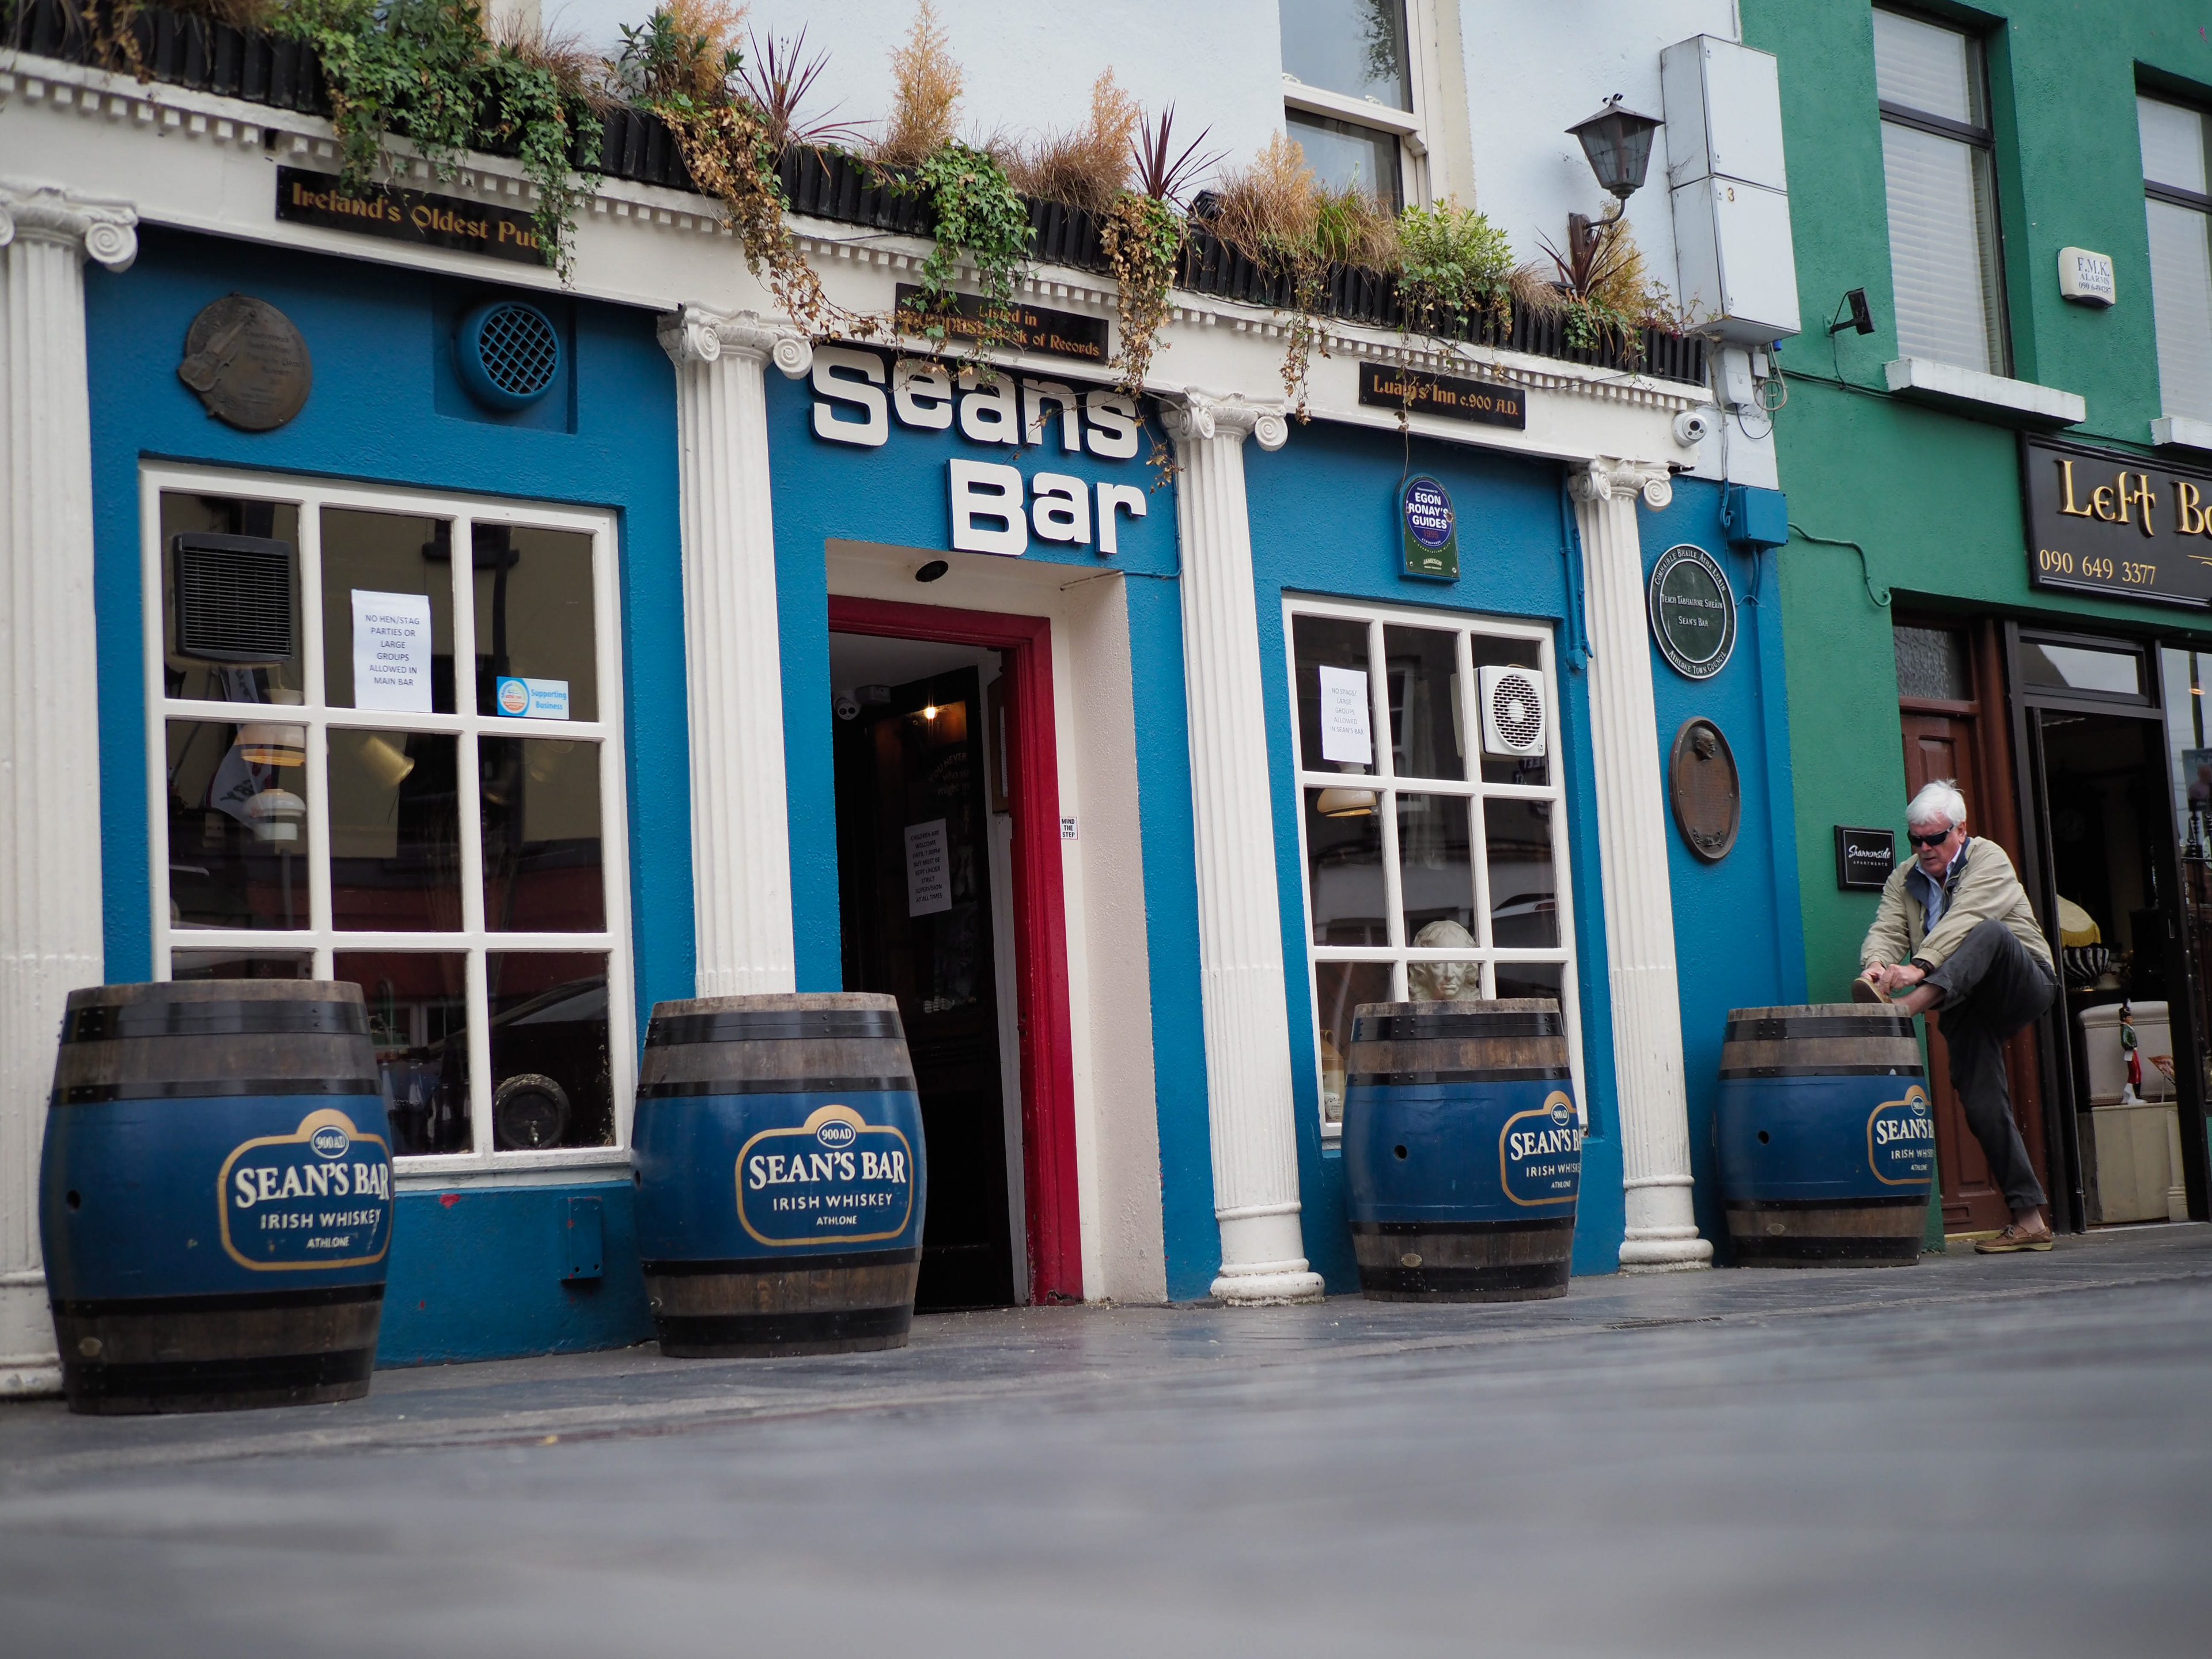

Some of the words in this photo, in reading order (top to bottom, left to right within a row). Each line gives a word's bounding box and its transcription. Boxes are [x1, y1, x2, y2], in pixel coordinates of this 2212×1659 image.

[1728, 187, 1735, 202] 3
[293, 182, 402, 222] Ireland's
[411, 204, 488, 239] Oldest
[2080, 273, 2109, 285] ALARMS
[1024, 310, 1039, 327] in
[1032, 334, 1046, 348] of
[1050, 334, 1101, 357] Records
[1433, 383, 1457, 405] Inn
[812, 346, 1139, 459] Seans
[1415, 492, 1441, 506] EGON
[2056, 459, 2156, 537] Left
[948, 458, 1147, 555] Bar
[1408, 502, 1450, 517] RONAY'S
[1412, 515, 1447, 529] GUIDES
[1423, 529, 1439, 539] 1995
[2039, 549, 2074, 574] 090
[2082, 555, 2113, 579] 649
[2122, 561, 2157, 585] 3377
[365, 614, 378, 623] NO
[380, 615, 420, 625] HEN/STAG
[370, 627, 403, 637] PARTIES
[404, 629, 416, 637] OR
[380, 640, 406, 649] LARGE
[377, 652, 410, 661] GROUPS
[1692, 665, 1707, 675] TOWN
[1707, 651, 1726, 673] COUNCIL
[369, 664, 407, 674] ALLOWED
[409, 666, 418, 675] IN
[374, 677, 396, 685] MAIN
[398, 678, 414, 686] BAR
[531, 689, 567, 700] Supporting
[536, 700, 563, 710] Business
[1335, 707, 1355, 715] GROUPS
[1334, 717, 1358, 725] ALLOWED
[944, 752, 967, 768] NEVER
[915, 839, 936, 849] WELCOME
[915, 884, 942, 894] SUPERVISION
[1876, 1118, 1927, 1145] SEAN'S
[1510, 1128, 1571, 1161] SEAN'S
[1891, 1149, 1914, 1160] IRISH
[749, 1152, 857, 1190] SEAN'S
[861, 1150, 907, 1184] BAR
[1526, 1164, 1555, 1177] IRISH
[234, 1162, 350, 1209] SEAN'S
[353, 1162, 391, 1201] BAR
[773, 1195, 820, 1211] IRISH
[825, 1192, 893, 1209] WHISKEY
[260, 1213, 315, 1230] IRISH
[319, 1208, 382, 1229] WHISKEY
[816, 1215, 858, 1226] ATHLONE
[305, 1236, 351, 1249] ATHLONE
